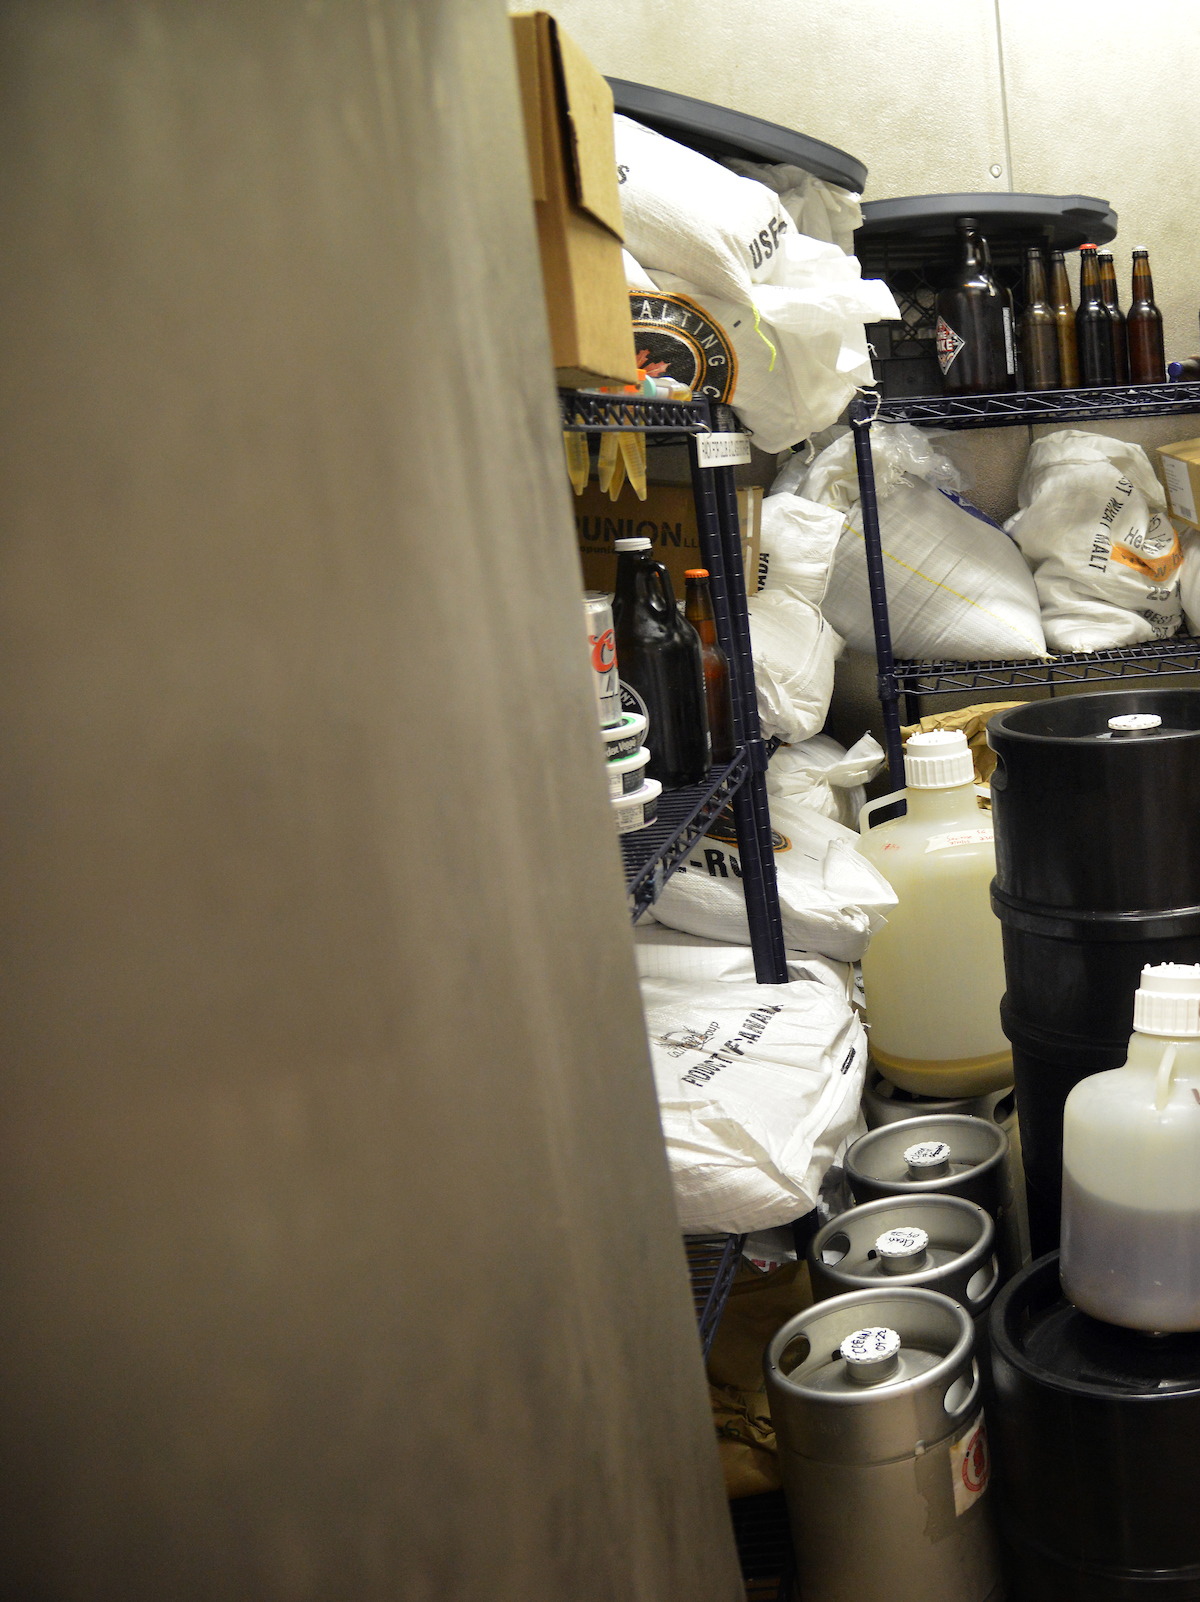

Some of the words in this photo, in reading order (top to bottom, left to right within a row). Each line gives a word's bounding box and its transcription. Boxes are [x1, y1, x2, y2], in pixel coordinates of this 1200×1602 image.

[639, 299, 726, 367] ALTING
[1116, 476, 1134, 496] ST
[575, 515, 682, 548] UNION
[1089, 533, 1111, 573] MALT
